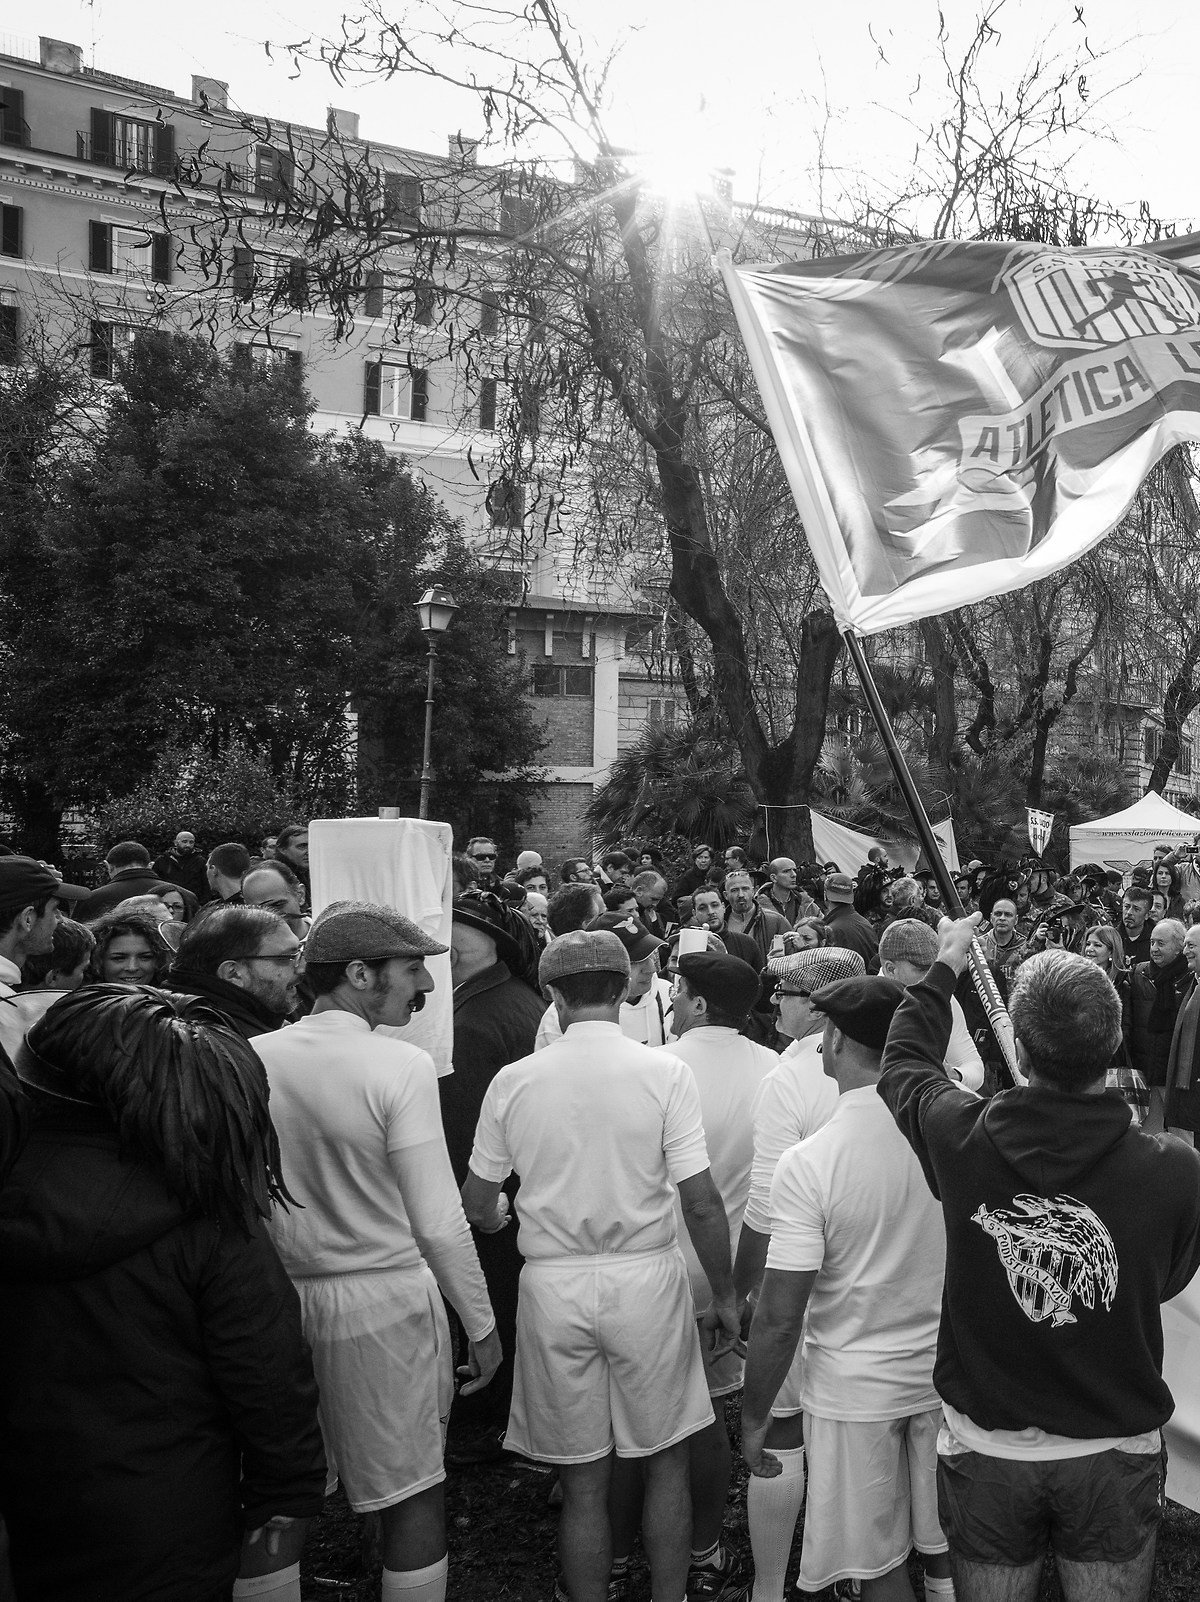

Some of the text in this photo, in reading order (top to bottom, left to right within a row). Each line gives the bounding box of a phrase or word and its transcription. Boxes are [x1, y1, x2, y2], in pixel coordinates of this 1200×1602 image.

[1079, 258, 1161, 273] LAZIO
[970, 355, 1149, 467] ATLETICA
[997, 1234, 1040, 1280] PODISTICA
[1041, 1275, 1068, 1304] LAZIO
